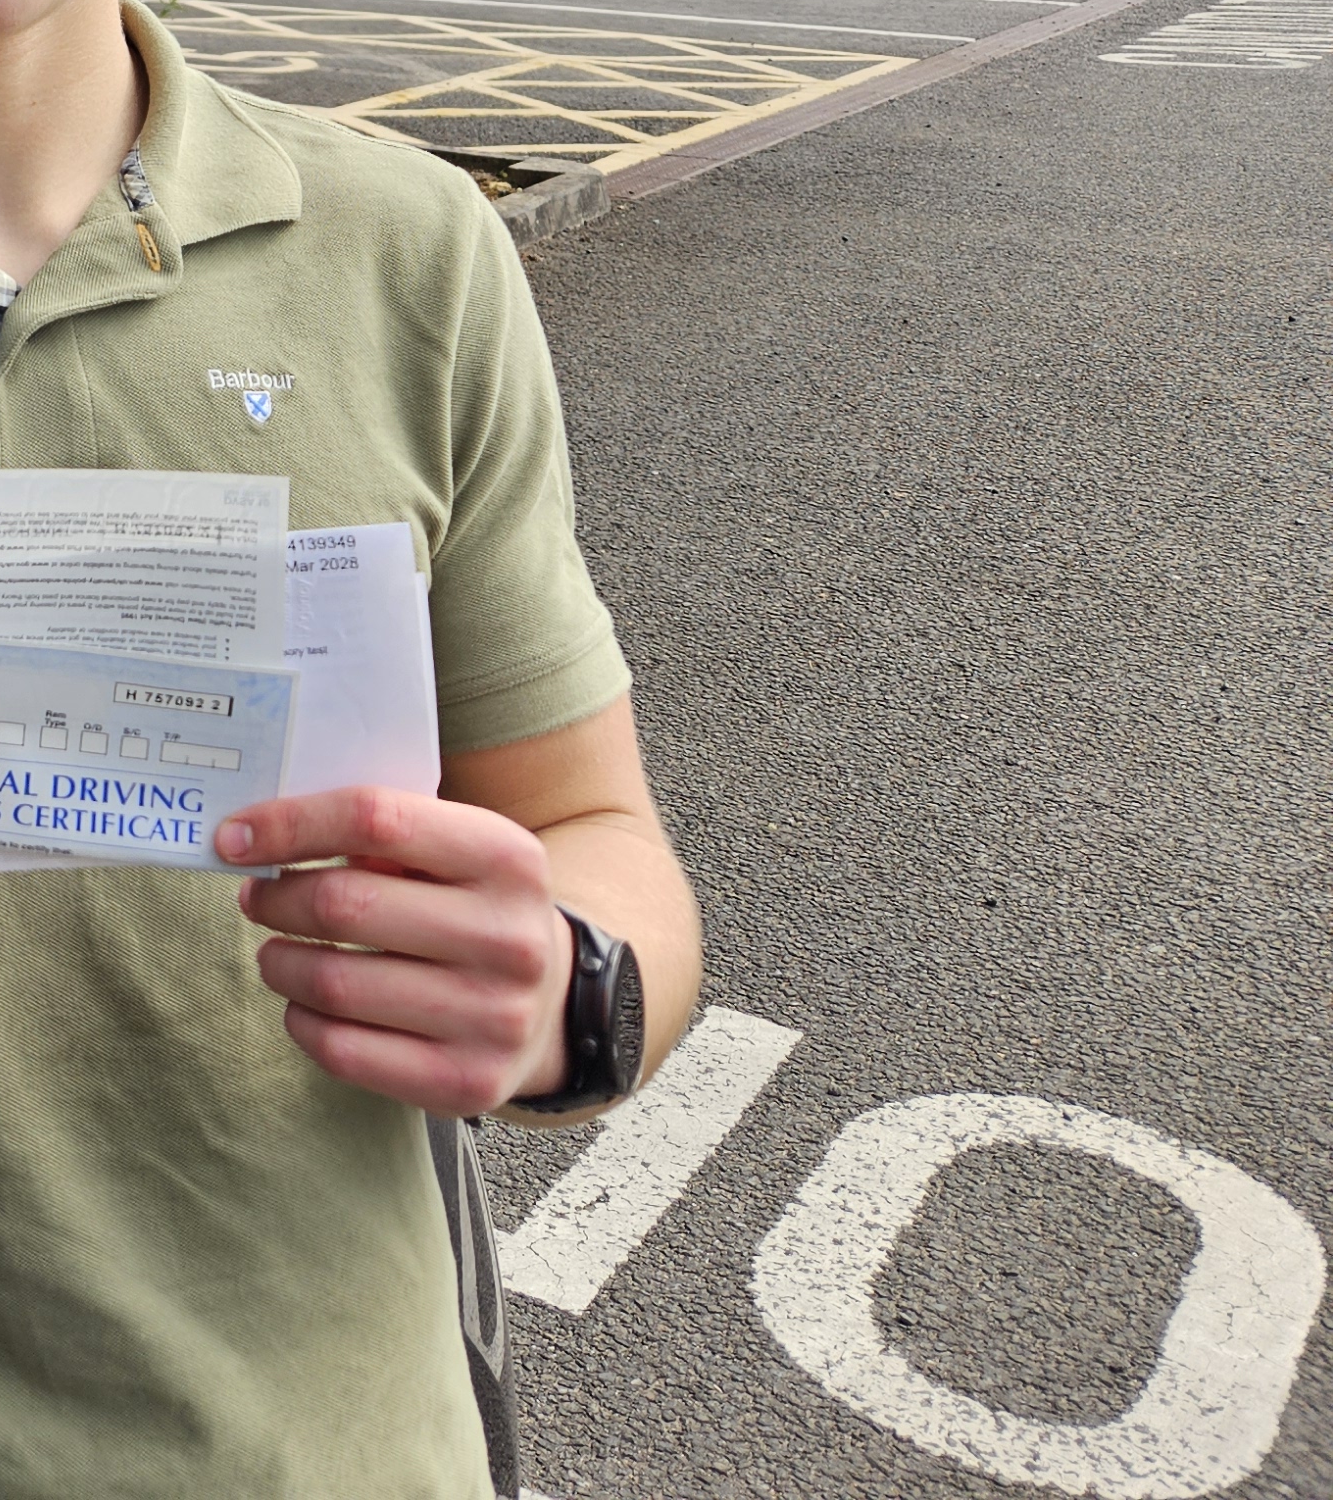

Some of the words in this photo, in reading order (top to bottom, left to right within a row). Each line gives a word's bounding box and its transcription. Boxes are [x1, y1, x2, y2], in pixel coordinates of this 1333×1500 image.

[208, 367, 295, 389] Barbour
[319, 556, 360, 571] 2028
[126, 688, 138, 701] H
[52, 774, 205, 814] DRIVING
[13, 803, 203, 845] CERTIFICATE
